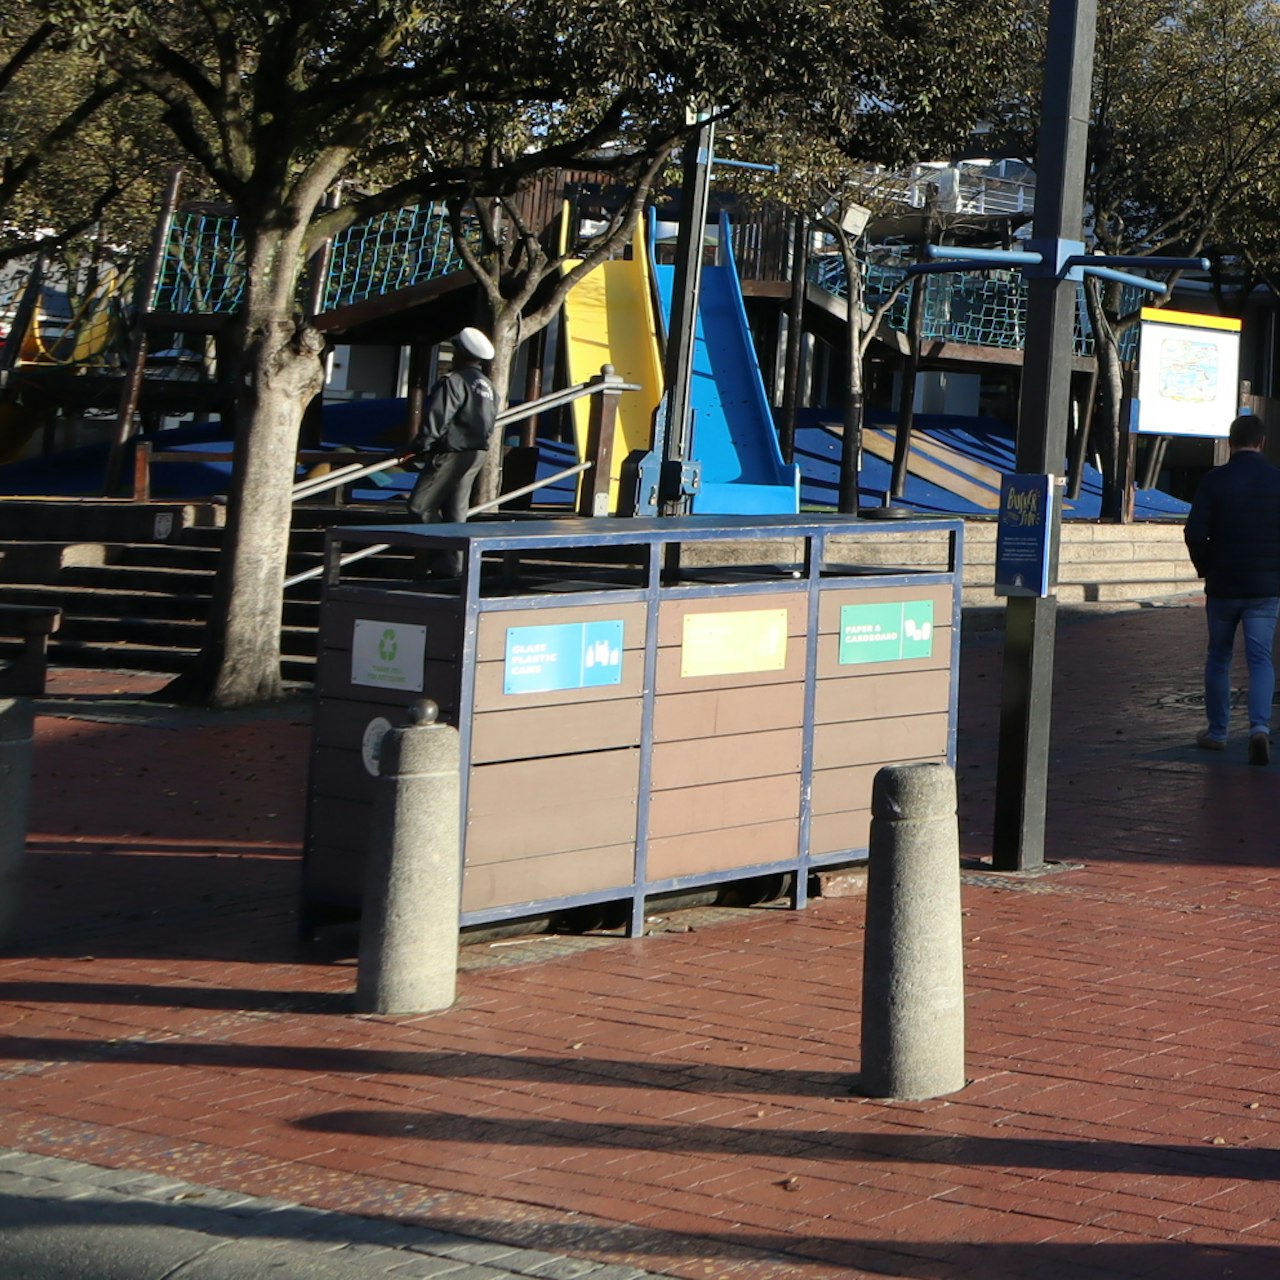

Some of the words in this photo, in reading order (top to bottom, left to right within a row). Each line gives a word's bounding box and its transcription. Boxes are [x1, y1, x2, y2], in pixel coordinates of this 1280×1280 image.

[846, 625, 873, 633] PAPER
[845, 632, 898, 642] CARDBOARD
[512, 643, 547, 653] GLASS
[512, 653, 558, 663] PLASTIC
[512, 665, 542, 675] CANS
